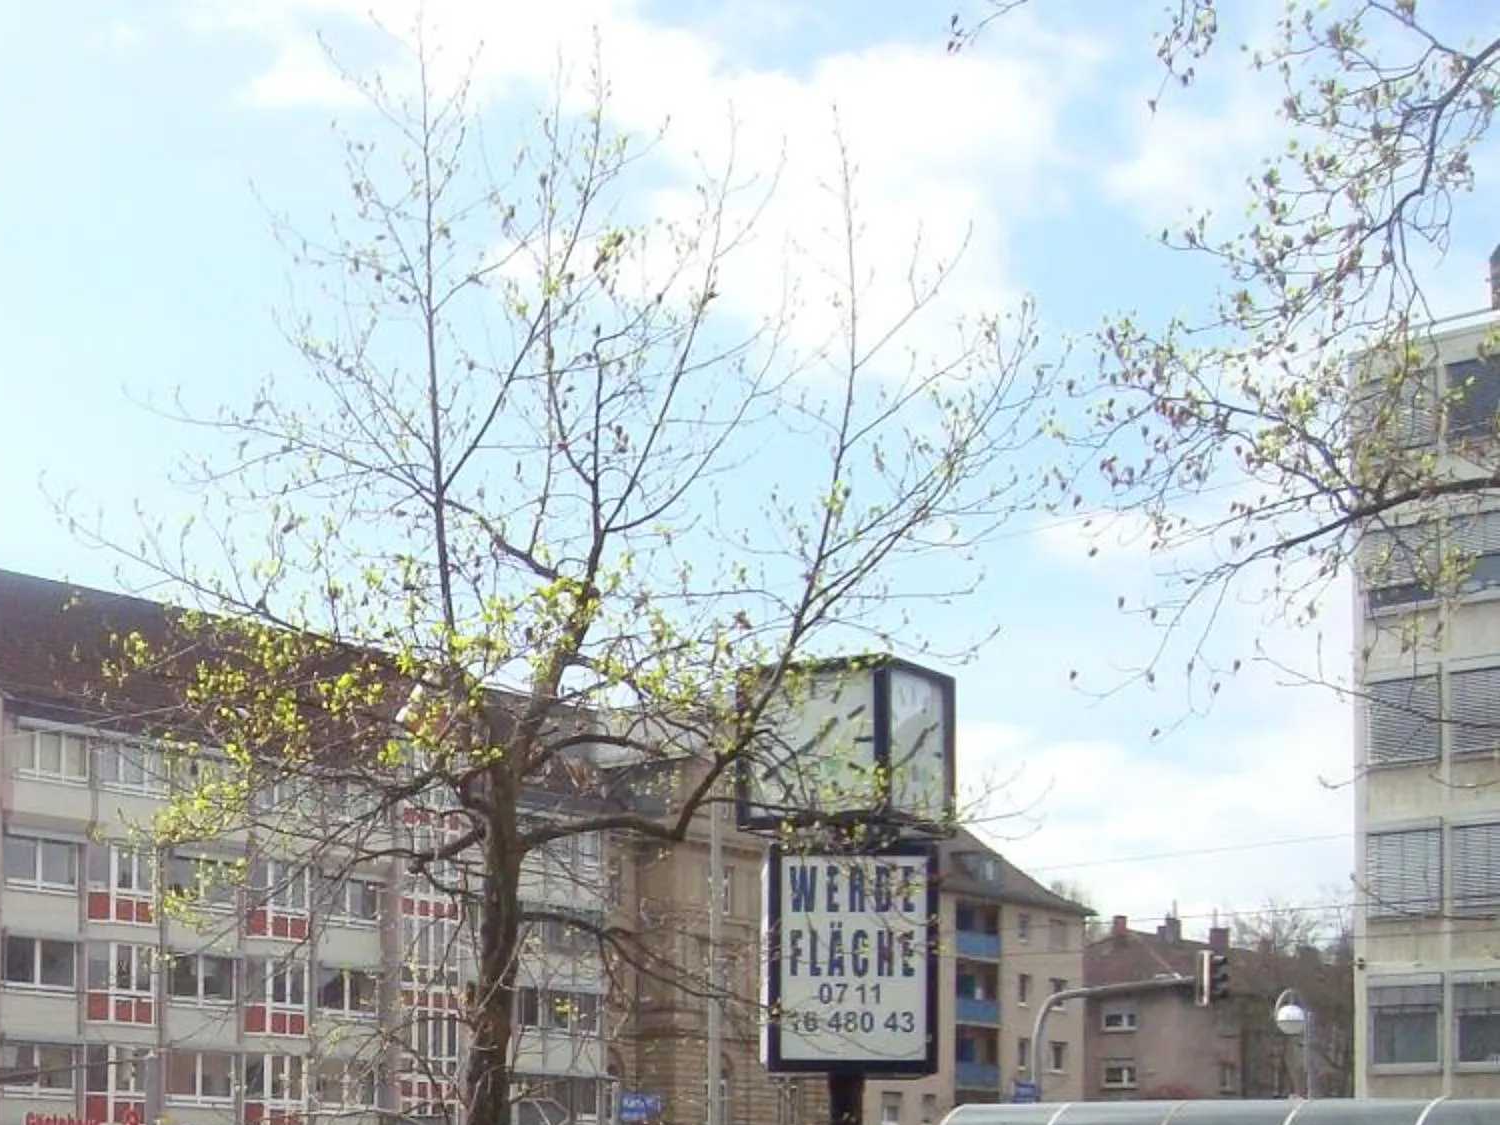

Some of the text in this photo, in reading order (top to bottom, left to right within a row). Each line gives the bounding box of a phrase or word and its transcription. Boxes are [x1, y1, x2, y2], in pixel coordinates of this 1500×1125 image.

[789, 921, 916, 978] FLÄCHE
[827, 1011, 874, 1033] 480
[884, 1011, 915, 1033] 43
